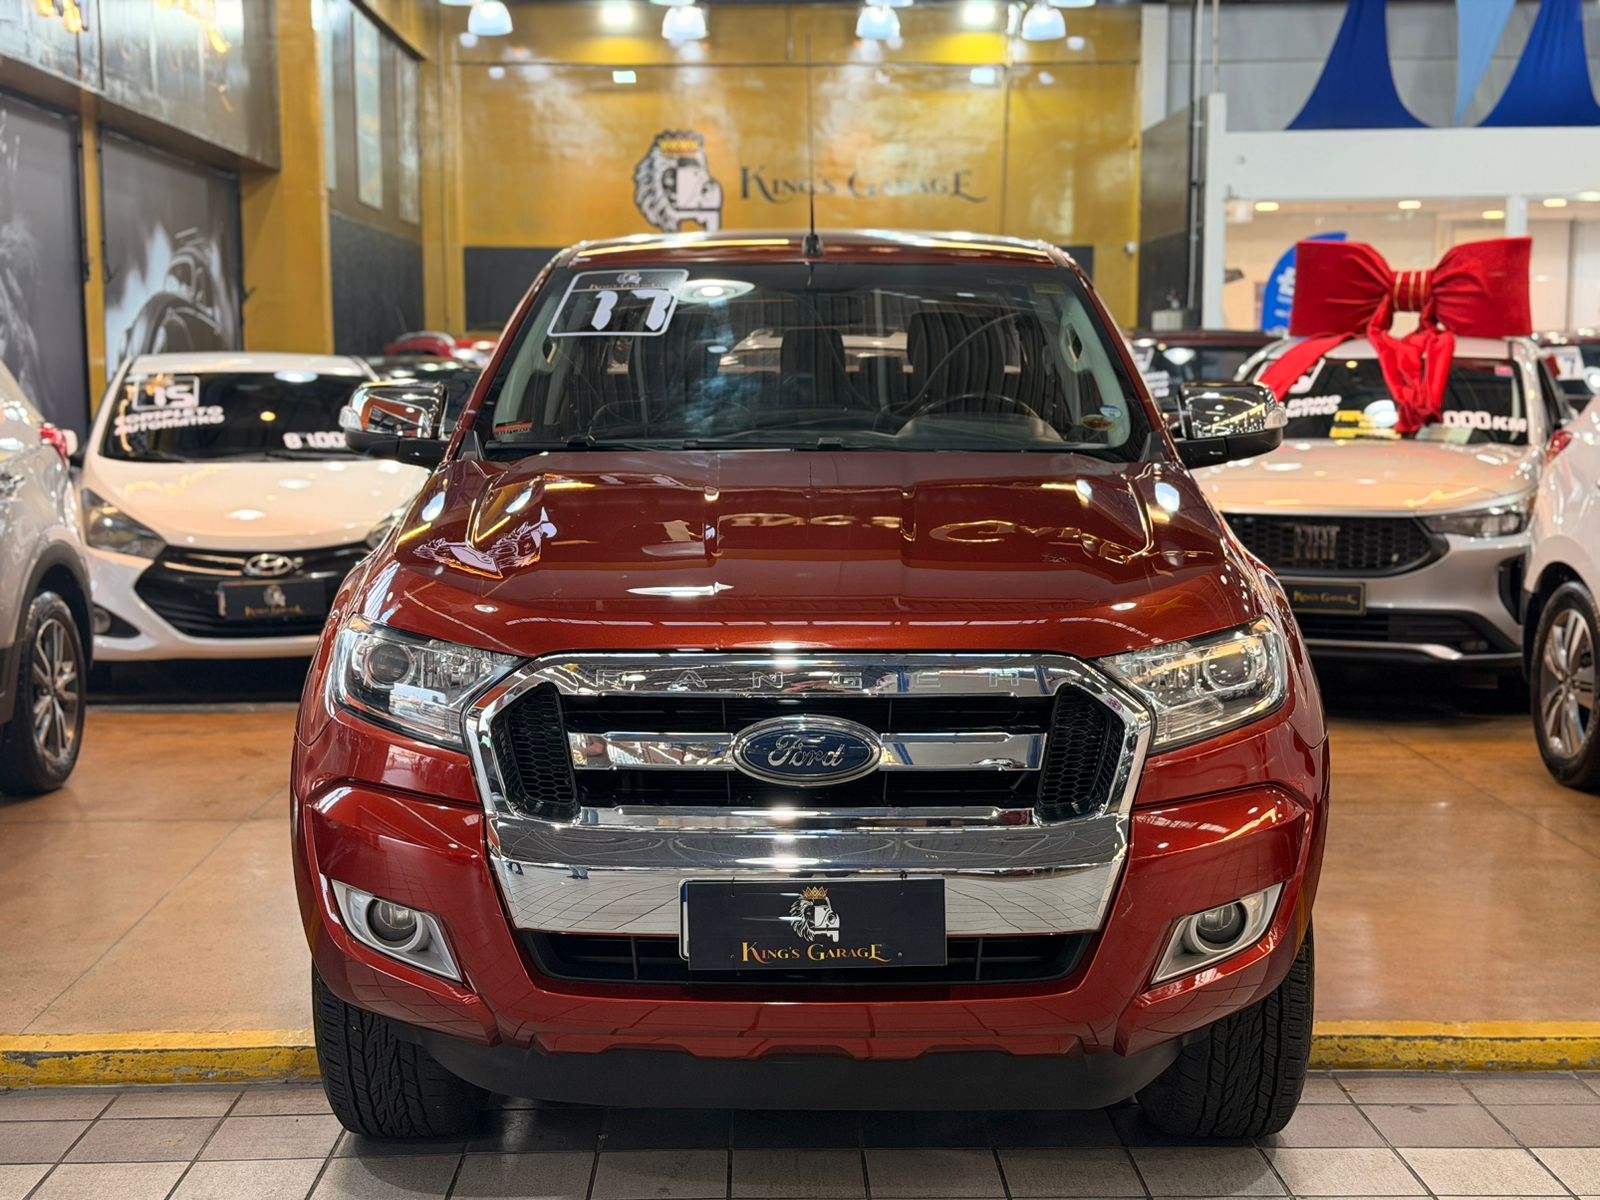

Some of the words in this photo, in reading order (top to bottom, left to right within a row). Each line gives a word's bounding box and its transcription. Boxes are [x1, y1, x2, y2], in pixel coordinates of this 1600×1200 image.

[591, 290, 672, 331] 17
[1492, 416, 1527, 432] KM
[596, 669, 1019, 689] RANGER
[767, 734, 845, 767] Ford
[741, 941, 800, 964] KING'S
[807, 943, 892, 963] GARAGE
